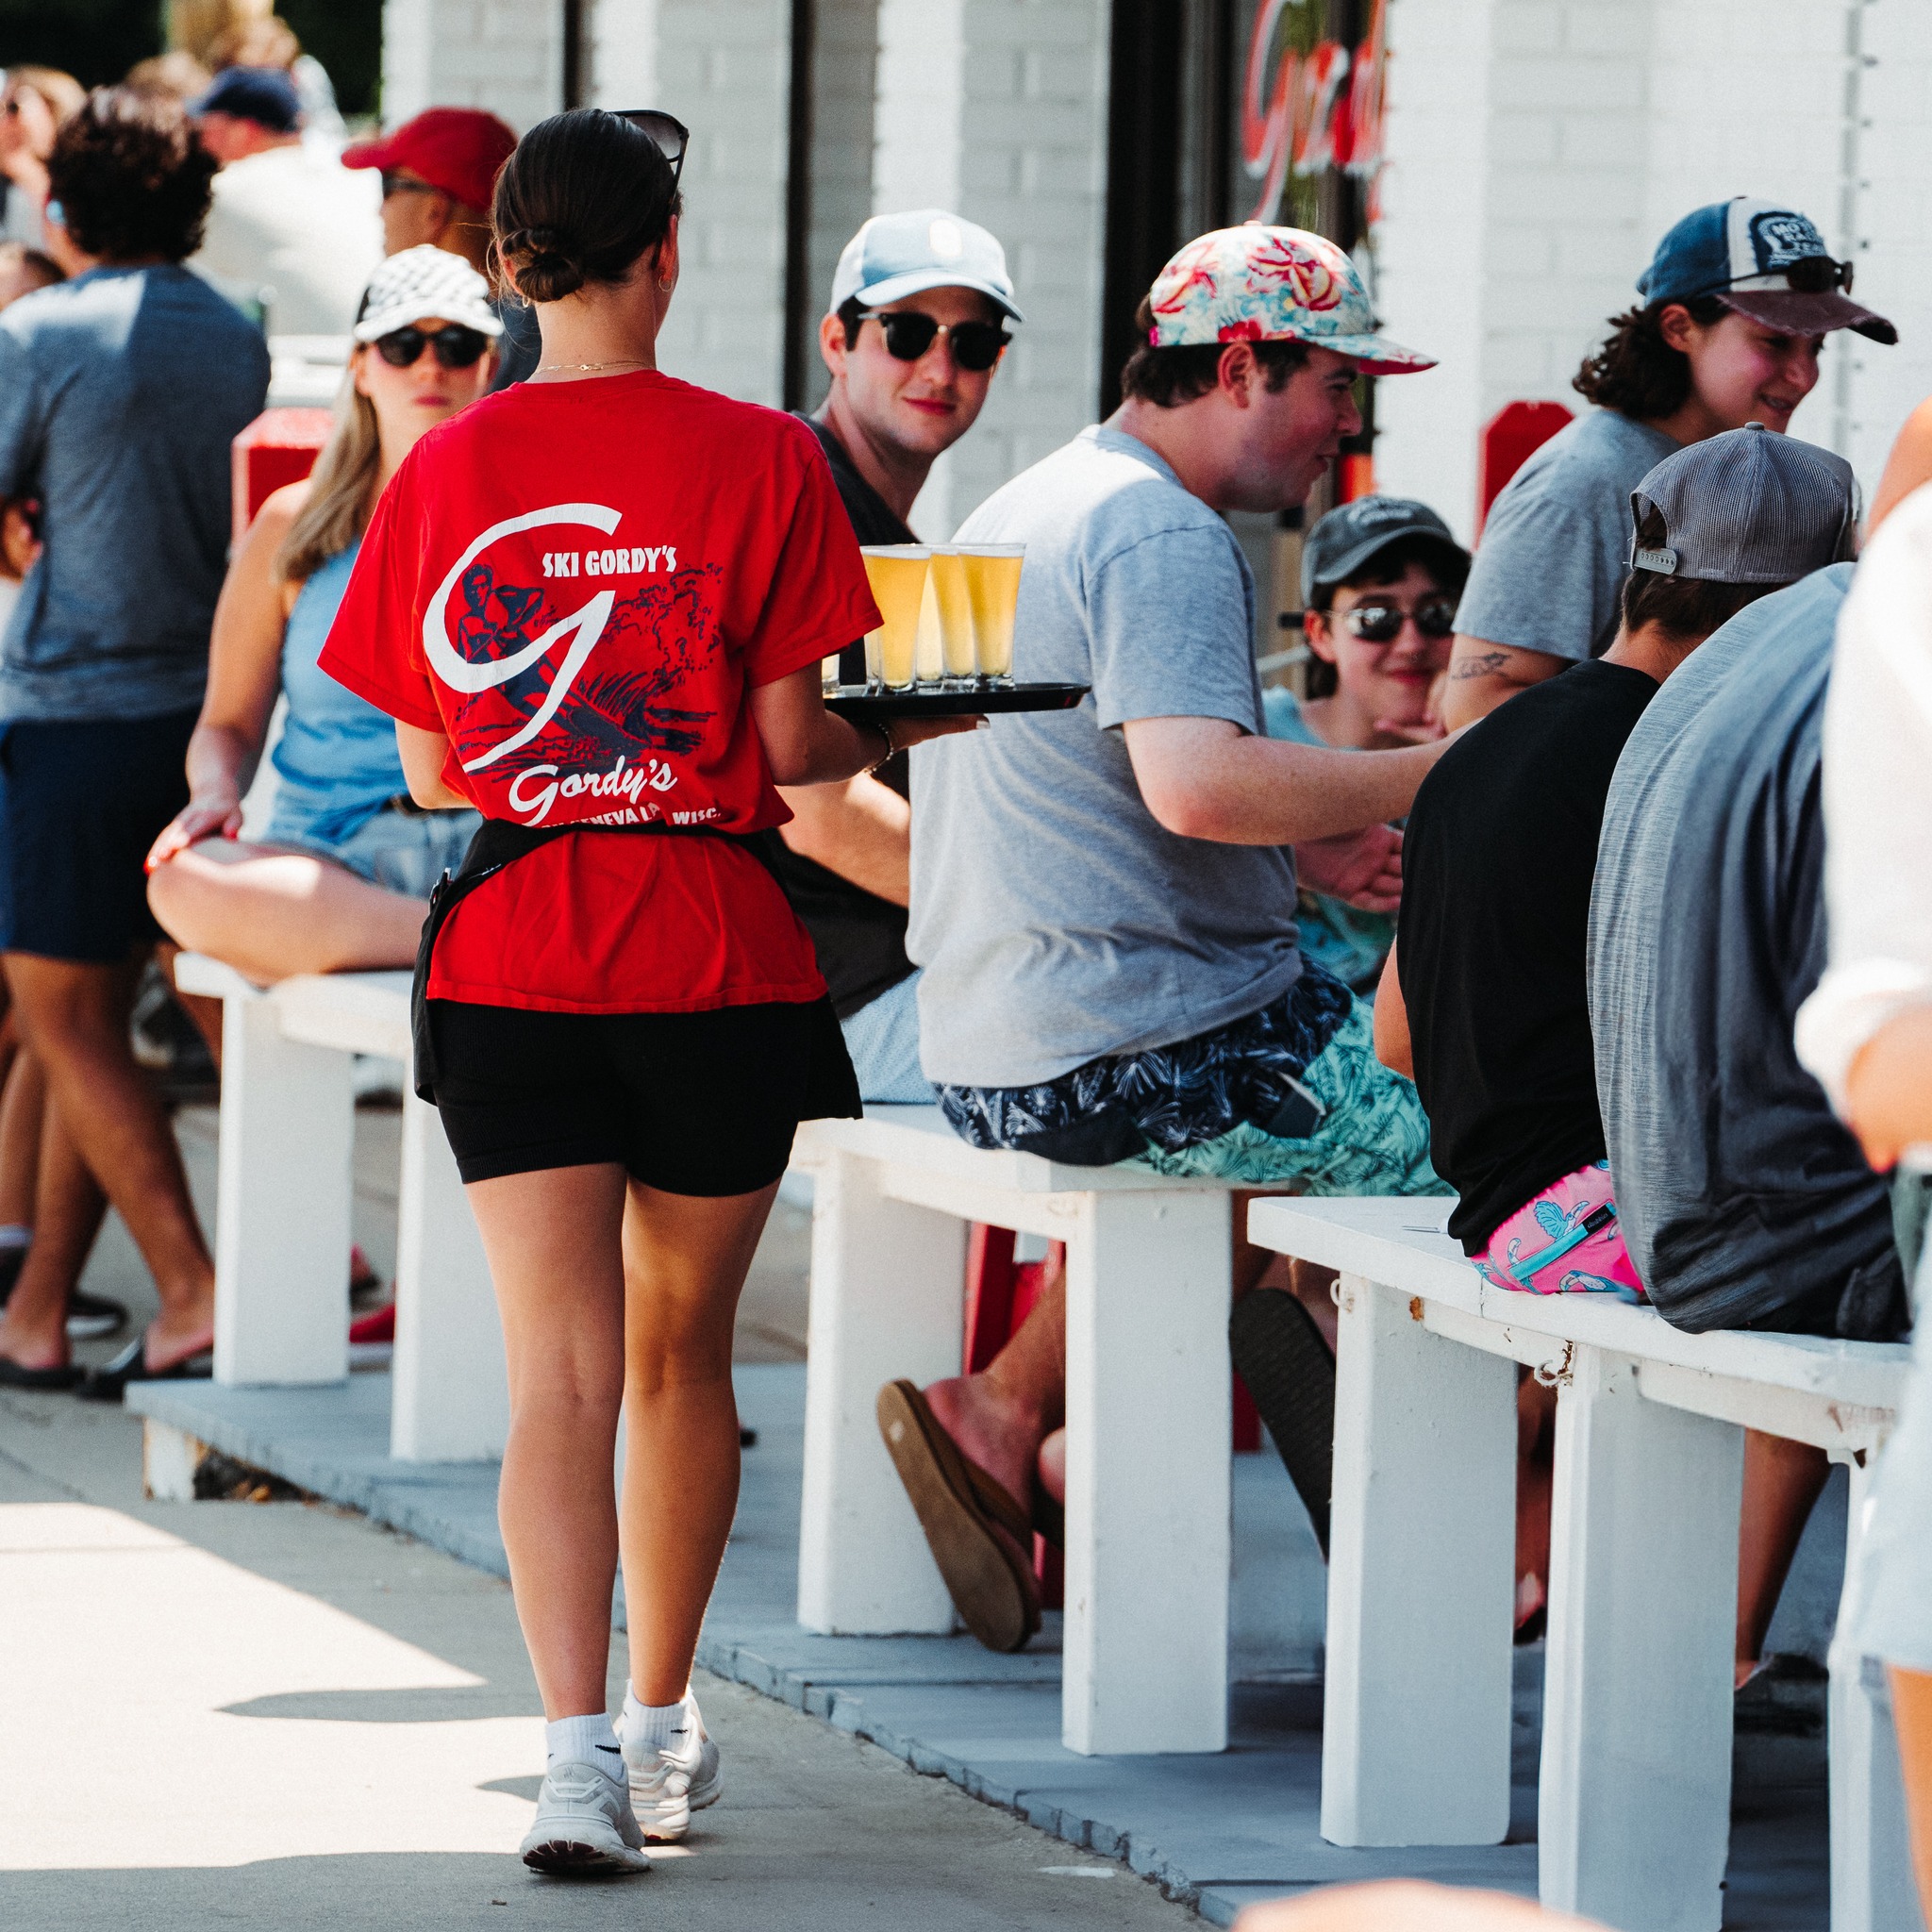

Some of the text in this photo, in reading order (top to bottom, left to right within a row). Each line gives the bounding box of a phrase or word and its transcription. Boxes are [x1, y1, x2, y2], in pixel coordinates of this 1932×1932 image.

[541, 544, 677, 578] SKI GORDY'S
[508, 755, 678, 828] Gordy's
